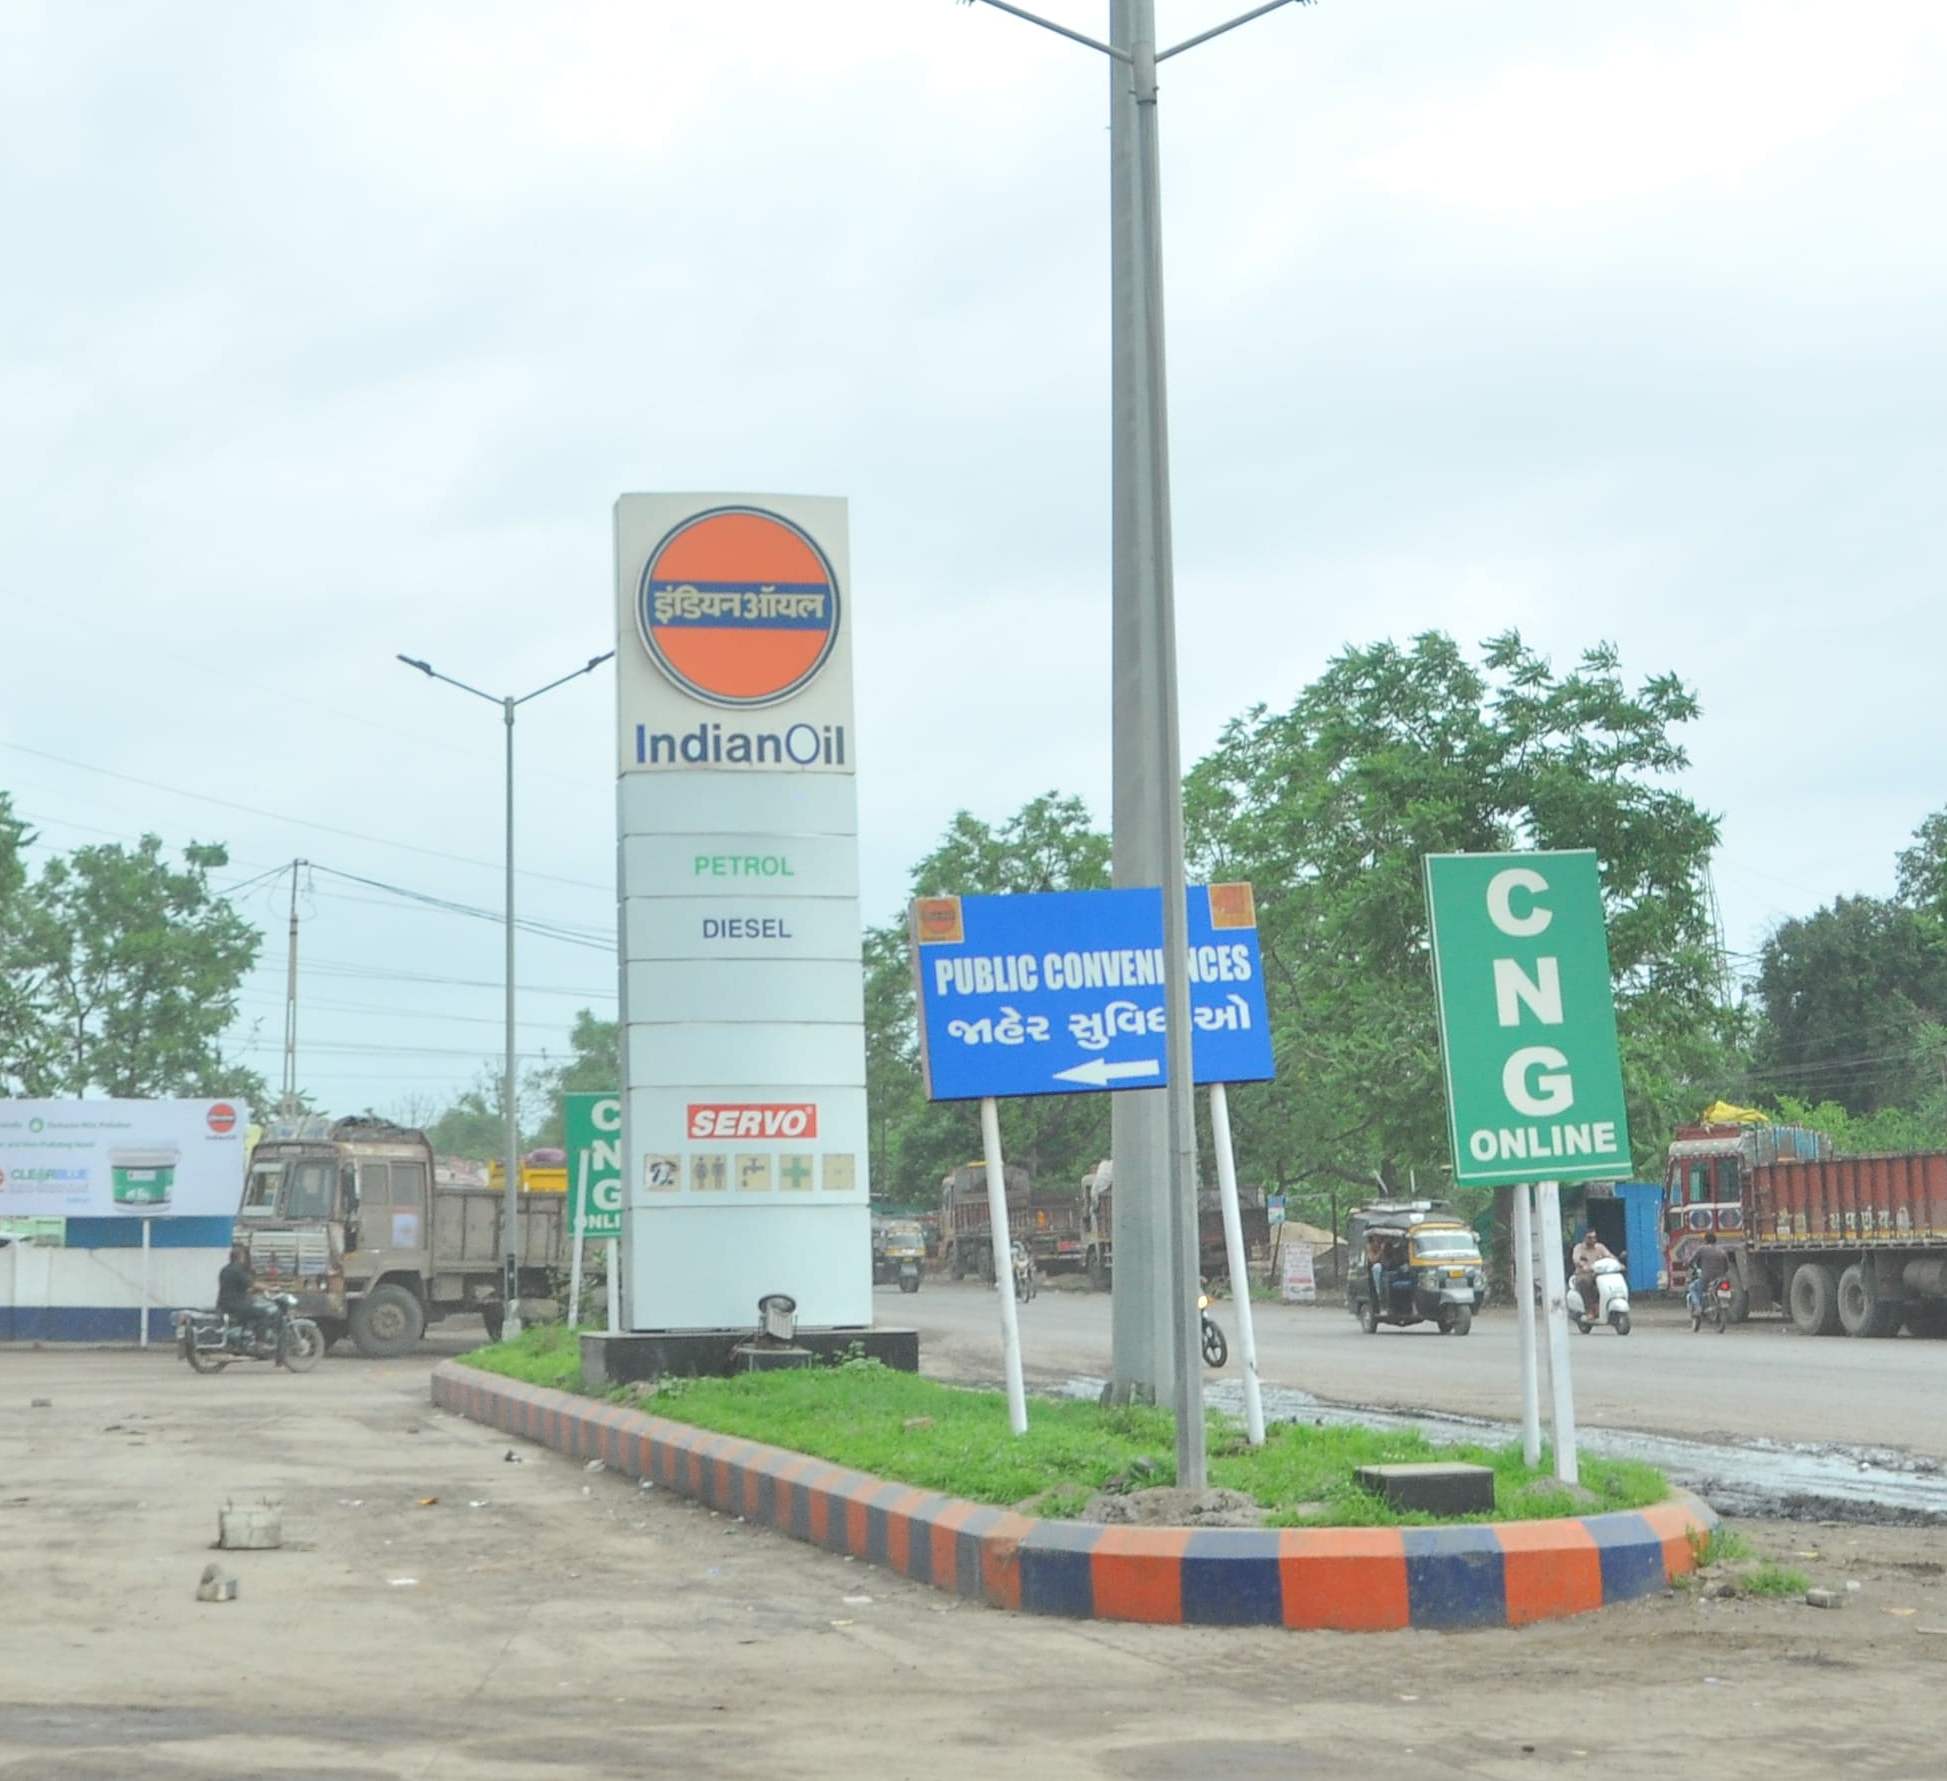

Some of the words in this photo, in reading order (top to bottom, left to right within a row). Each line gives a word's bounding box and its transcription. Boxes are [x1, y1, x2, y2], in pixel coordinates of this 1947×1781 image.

[635, 723, 845, 765] IndianOil
[693, 855, 795, 877] PETROL
[702, 918, 793, 939] DIESEL
[935, 954, 1039, 996] PUBLIC
[1043, 943, 1252, 990] CONVENINCES
[948, 1006, 1051, 1046] જાહેર
[1068, 993, 1251, 1051] સુવિધઓ
[690, 1109, 808, 1138] SERVO
[1469, 1121, 1617, 1161] ONLINE
